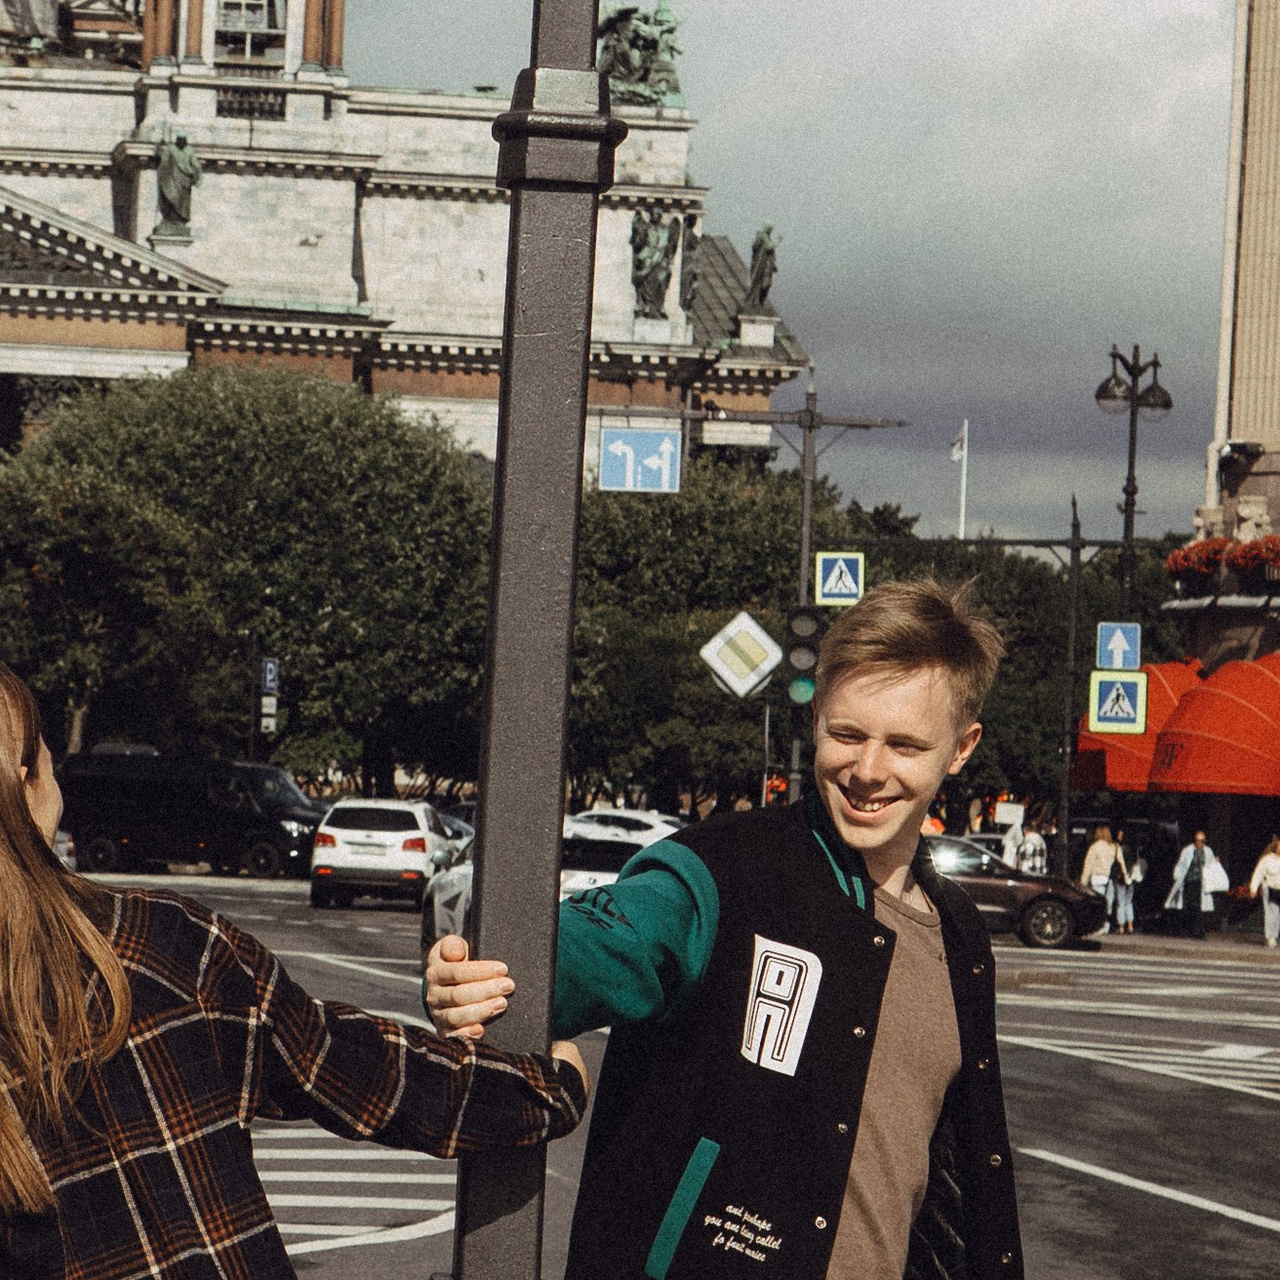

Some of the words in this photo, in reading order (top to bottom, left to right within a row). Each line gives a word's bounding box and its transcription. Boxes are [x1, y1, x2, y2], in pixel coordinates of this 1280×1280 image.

[725, 1205, 744, 1217] and
[704, 1215, 723, 1226] you
[724, 1221, 740, 1233] are
